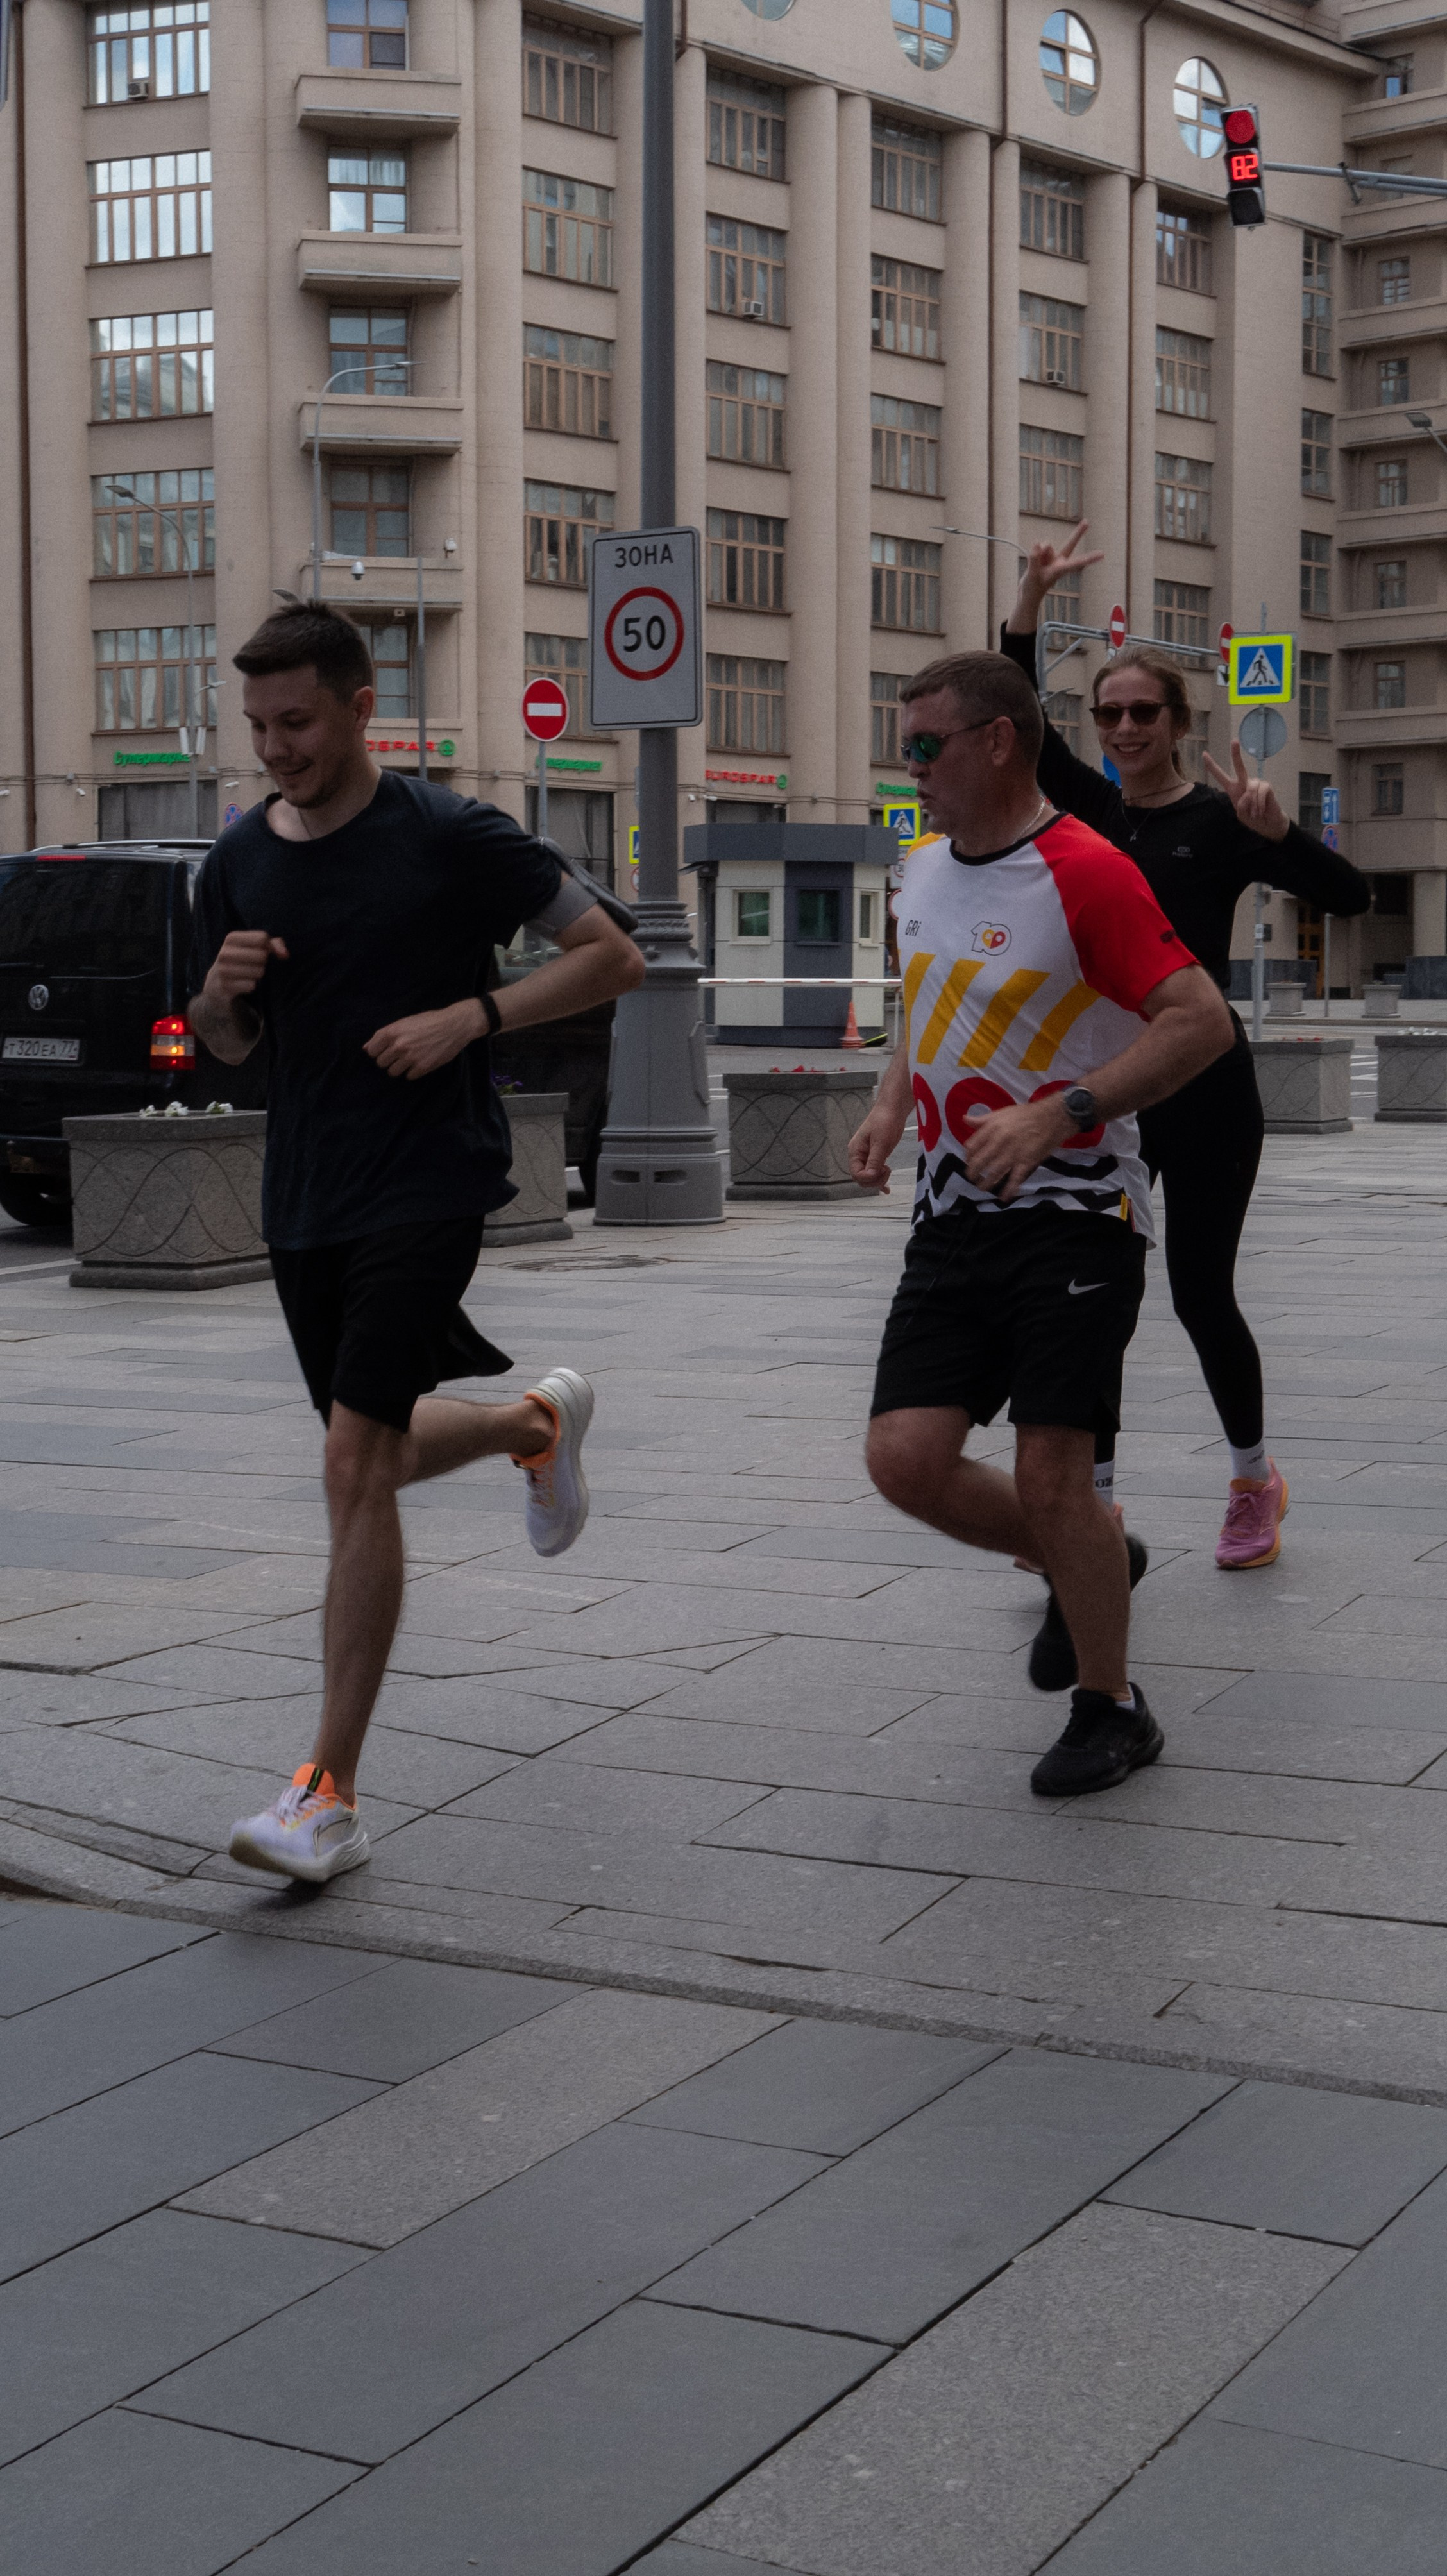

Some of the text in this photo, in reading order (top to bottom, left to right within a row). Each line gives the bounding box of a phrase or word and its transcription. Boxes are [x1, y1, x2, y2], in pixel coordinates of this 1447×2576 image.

[1231, 154, 1258, 180] 82
[614, 543, 673, 568] ЗОНА
[623, 615, 666, 652] 50
[365, 739, 435, 752] OSPAR
